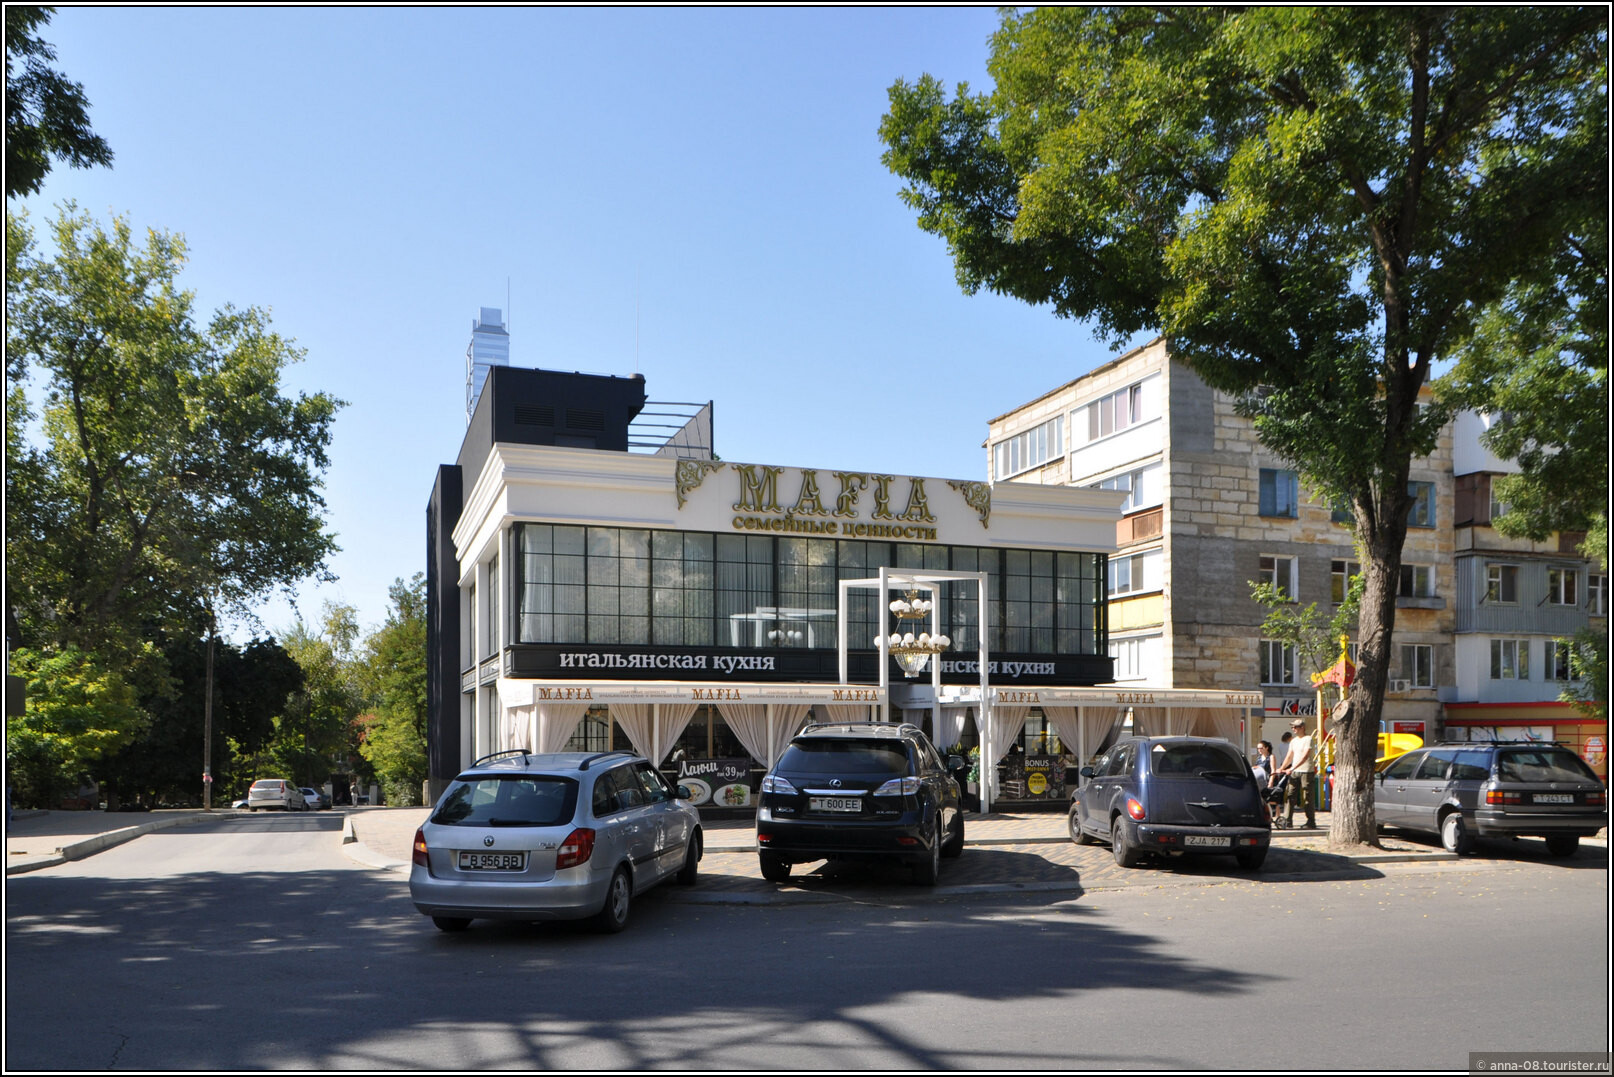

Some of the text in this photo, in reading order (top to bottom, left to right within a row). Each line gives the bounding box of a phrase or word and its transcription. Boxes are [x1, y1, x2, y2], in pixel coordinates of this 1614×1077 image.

[732, 463, 937, 523] MAFIA
[732, 514, 937, 540] семейные ценности
[559, 653, 775, 674] итальянская кухня
[1001, 661, 1056, 678] кухня
[538, 687, 594, 700] MAFIA
[691, 688, 742, 700] MAFIA
[832, 689, 879, 701] MAFIA
[998, 692, 1040, 703] MAFIA
[1116, 693, 1155, 704] MAFIA
[1225, 694, 1262, 705] MAFIA
[1024, 759, 1050, 767] BONUS
[725, 766, 736, 777] 39
[819, 799, 858, 809] T 600 EE
[1190, 837, 1226, 846] ZJA 217
[470, 855, 519, 867] B 956 BB
